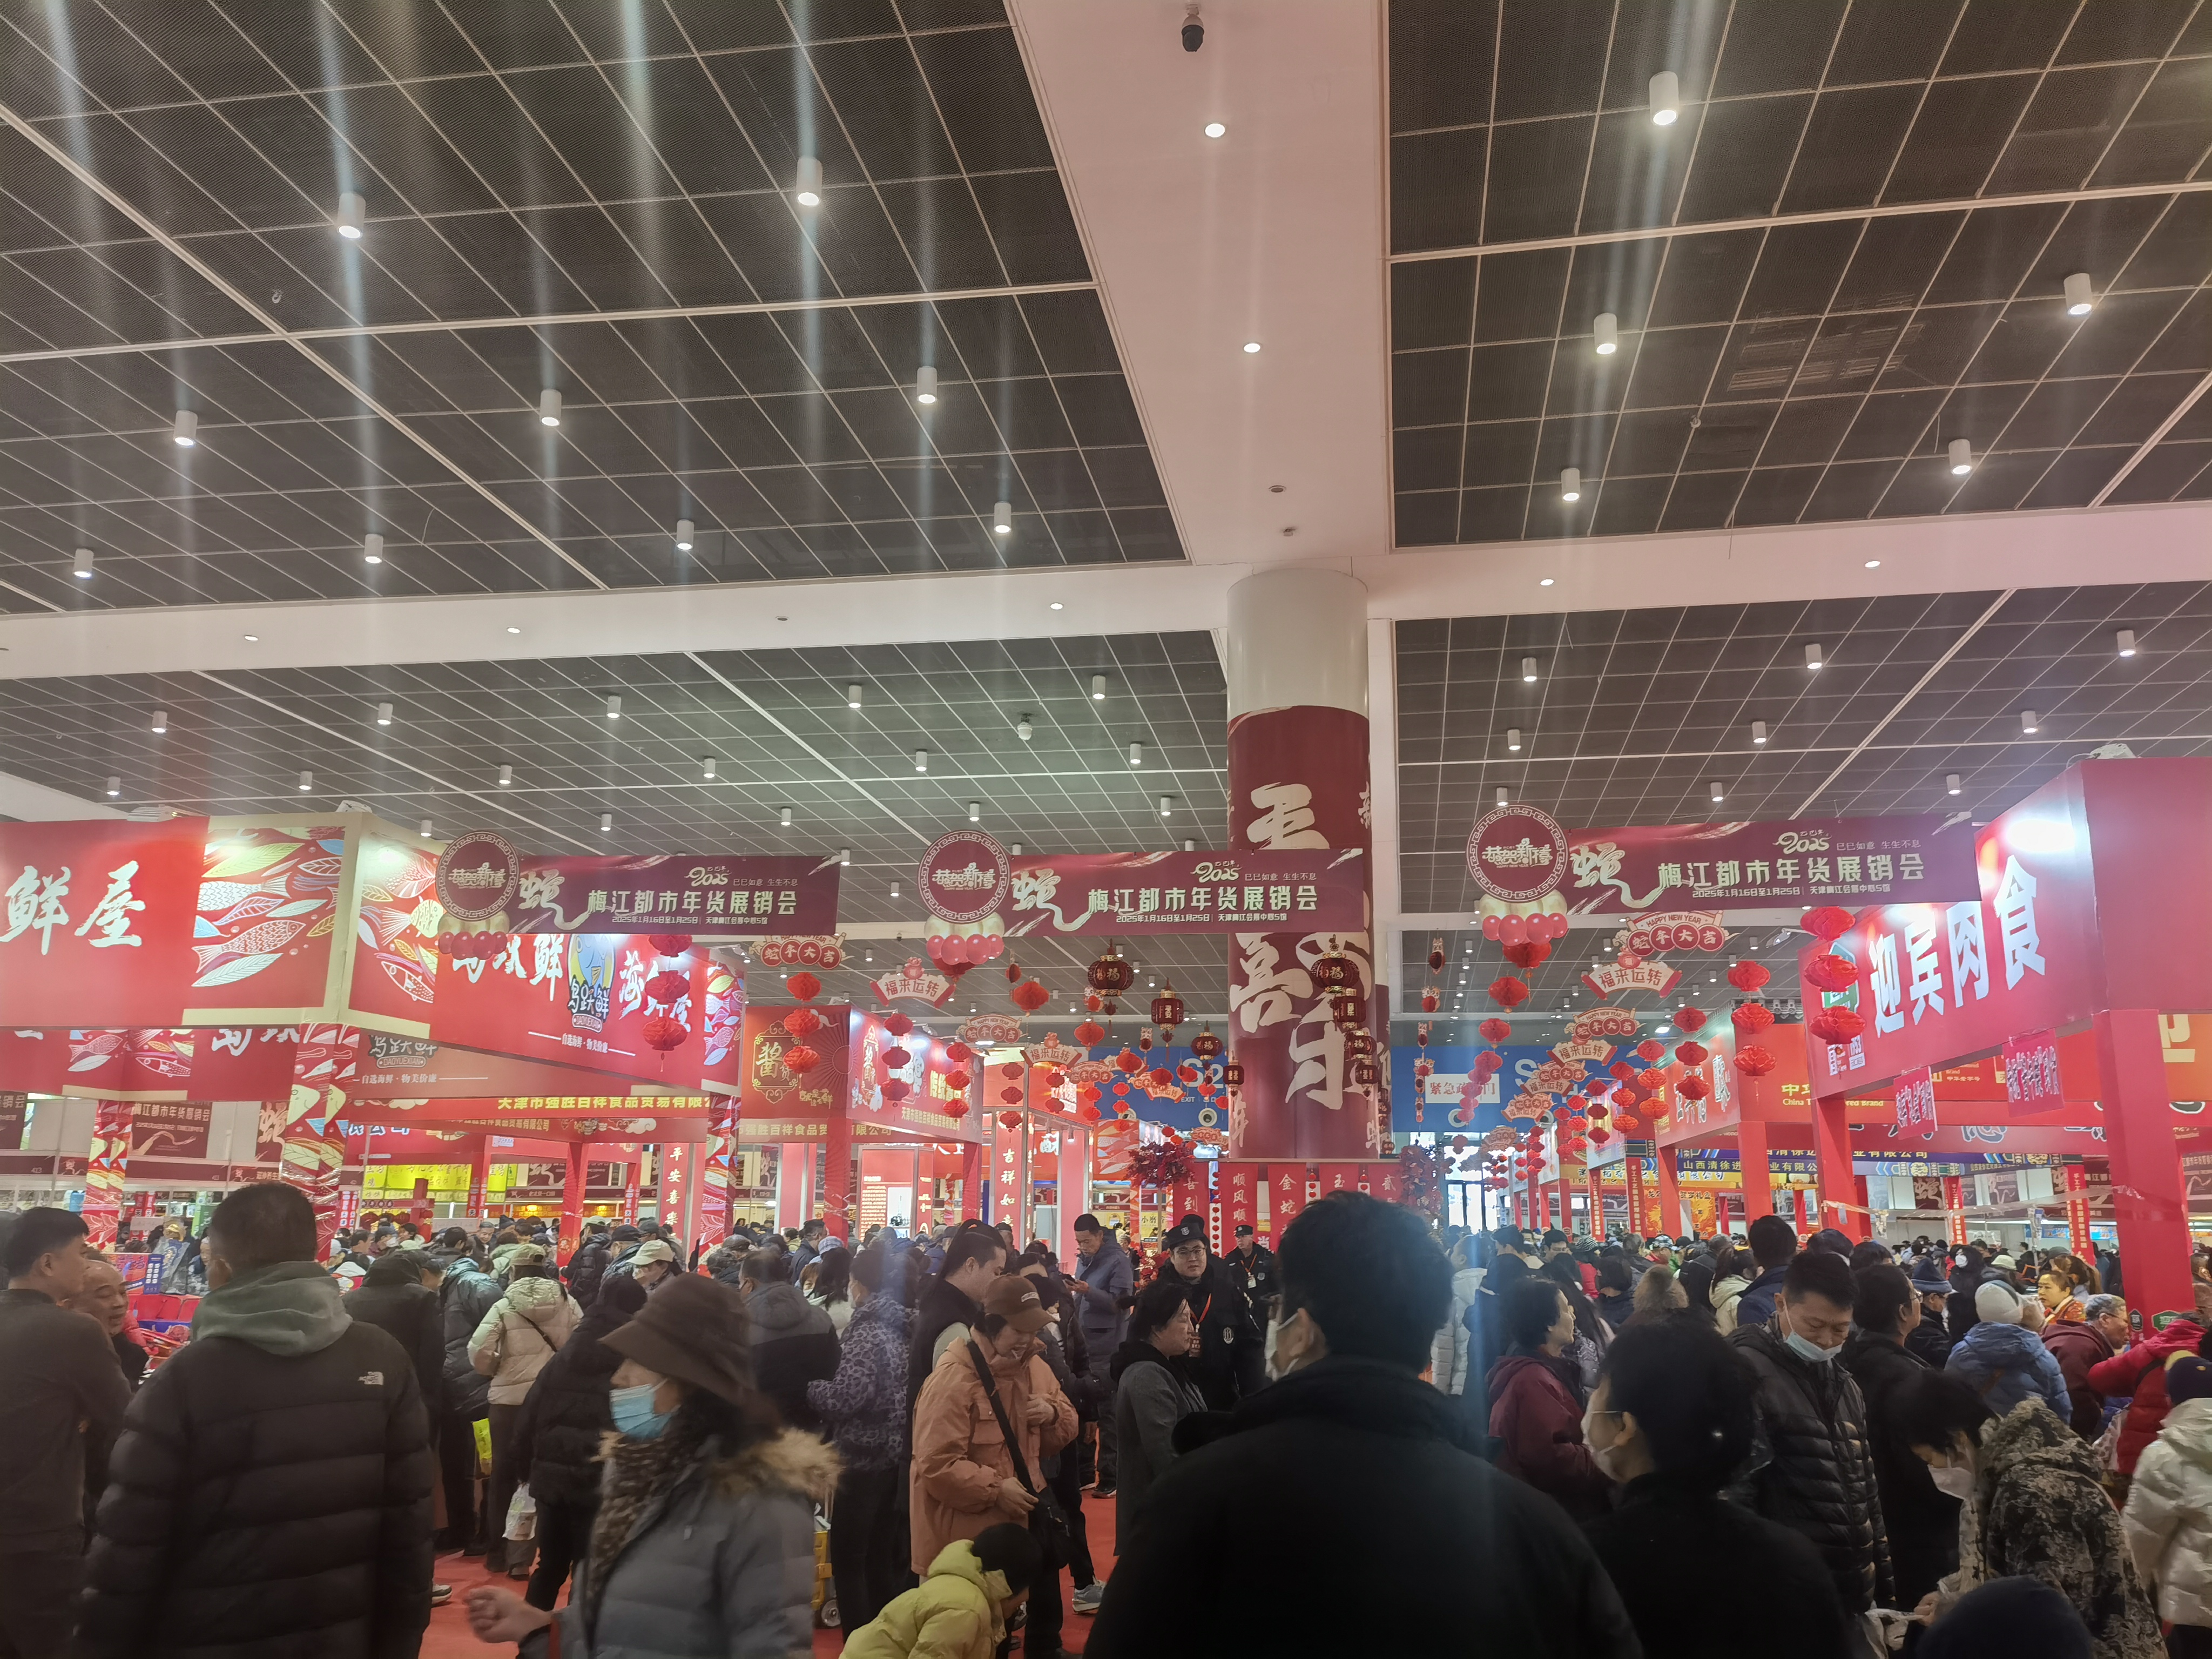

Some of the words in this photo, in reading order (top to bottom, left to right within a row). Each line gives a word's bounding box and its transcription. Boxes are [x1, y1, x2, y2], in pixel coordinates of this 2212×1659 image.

[1772, 832, 1832, 854] 2025
[1881, 840, 1921, 849] 生生不息
[1482, 838, 1553, 867] 恭贺新禧
[448, 862, 507, 888] 恭贺新禧
[684, 867, 732, 886] 2025
[932, 862, 996, 890] 恭贺新禧
[1190, 862, 1242, 883] 2025
[1283, 873, 1317, 881] 生生不息
[1658, 853, 1924, 888] 梅江都市年货展销会
[1088, 886, 1318, 913] 梅江都市年货展销会
[1691, 887, 1800, 898] 2025年1月16日至1月25日
[0, 860, 145, 955] 鲜屋
[589, 890, 797, 914] 梅江都市年货展销会
[612, 916, 698, 925] 2025年1月16日至1月25日
[1116, 914, 1210, 923] 2025年1月16日至1月25日
[1646, 915, 1667, 927] HAPPY
[1682, 915, 1702, 924] YEAR
[1632, 929, 1717, 949] 蛇年大吉
[1869, 854, 2045, 1038] 迎宾肉食
[764, 945, 836, 963] 蛇年大吉
[1107, 967, 1121, 981] 福
[1330, 966, 1344, 980] 福
[1599, 967, 1662, 989] 福来运转
[885, 979, 940, 997] 福来运转
[966, 1027, 1015, 1040] 蛇年大吉
[1576, 1021, 1632, 1036] 蛇年大吉
[1030, 1046, 1071, 1062] 福来运转
[1559, 1044, 1604, 1060] 福来运转
[1540, 1070, 1582, 1081] 蛇年大吉
[1430, 1082, 1495, 1095] 紧急门
[1529, 1081, 1564, 1093] 福来运转
[1000, 1148, 1016, 1227] 吉祥如意
[1680, 1191, 1712, 1200] 贺岁礼盒
[1233, 1172, 1247, 1229] 顺风顺
